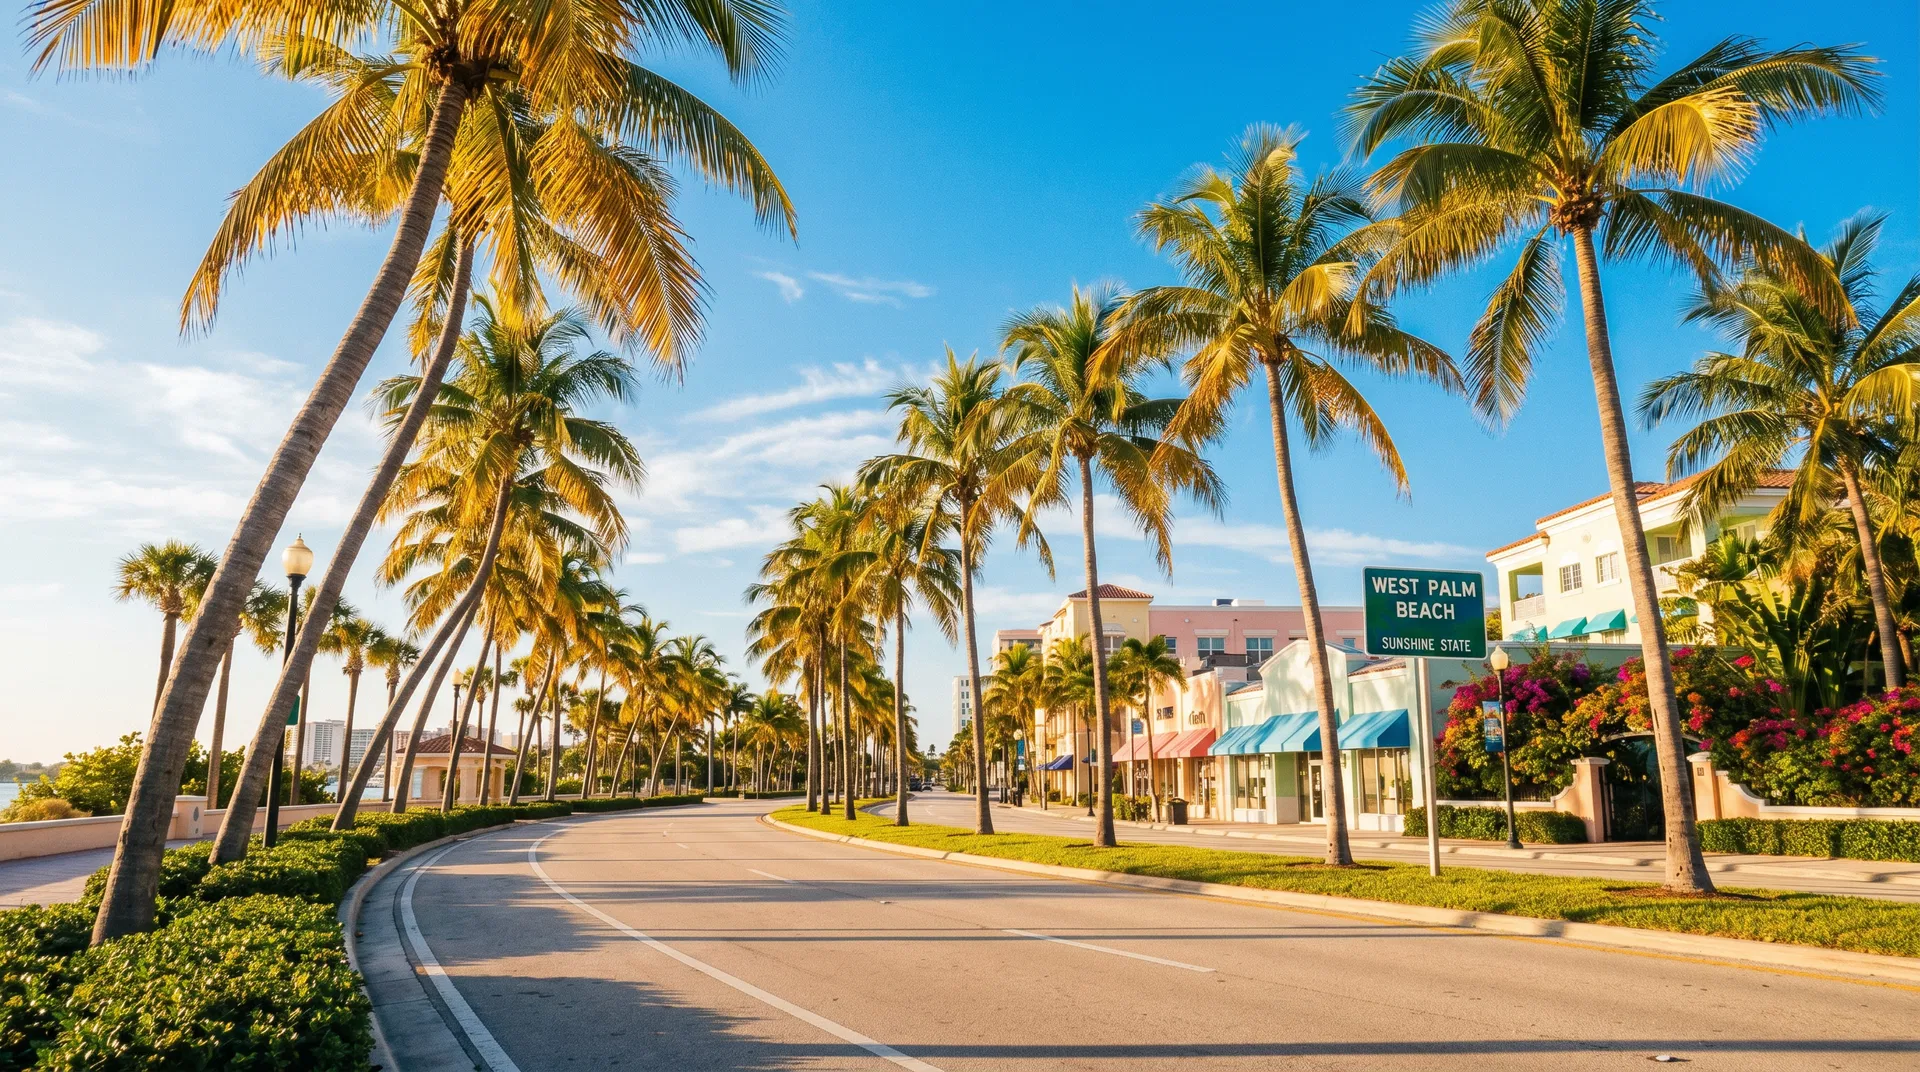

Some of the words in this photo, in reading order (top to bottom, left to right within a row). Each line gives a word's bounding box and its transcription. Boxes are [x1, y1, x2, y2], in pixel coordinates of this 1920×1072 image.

[1371, 576, 1419, 595] WEST
[1428, 579, 1477, 598] PALM
[1396, 601, 1455, 620] BEACH
[1381, 636, 1435, 651] SUNSHINE
[1440, 639, 1471, 652] STATE
